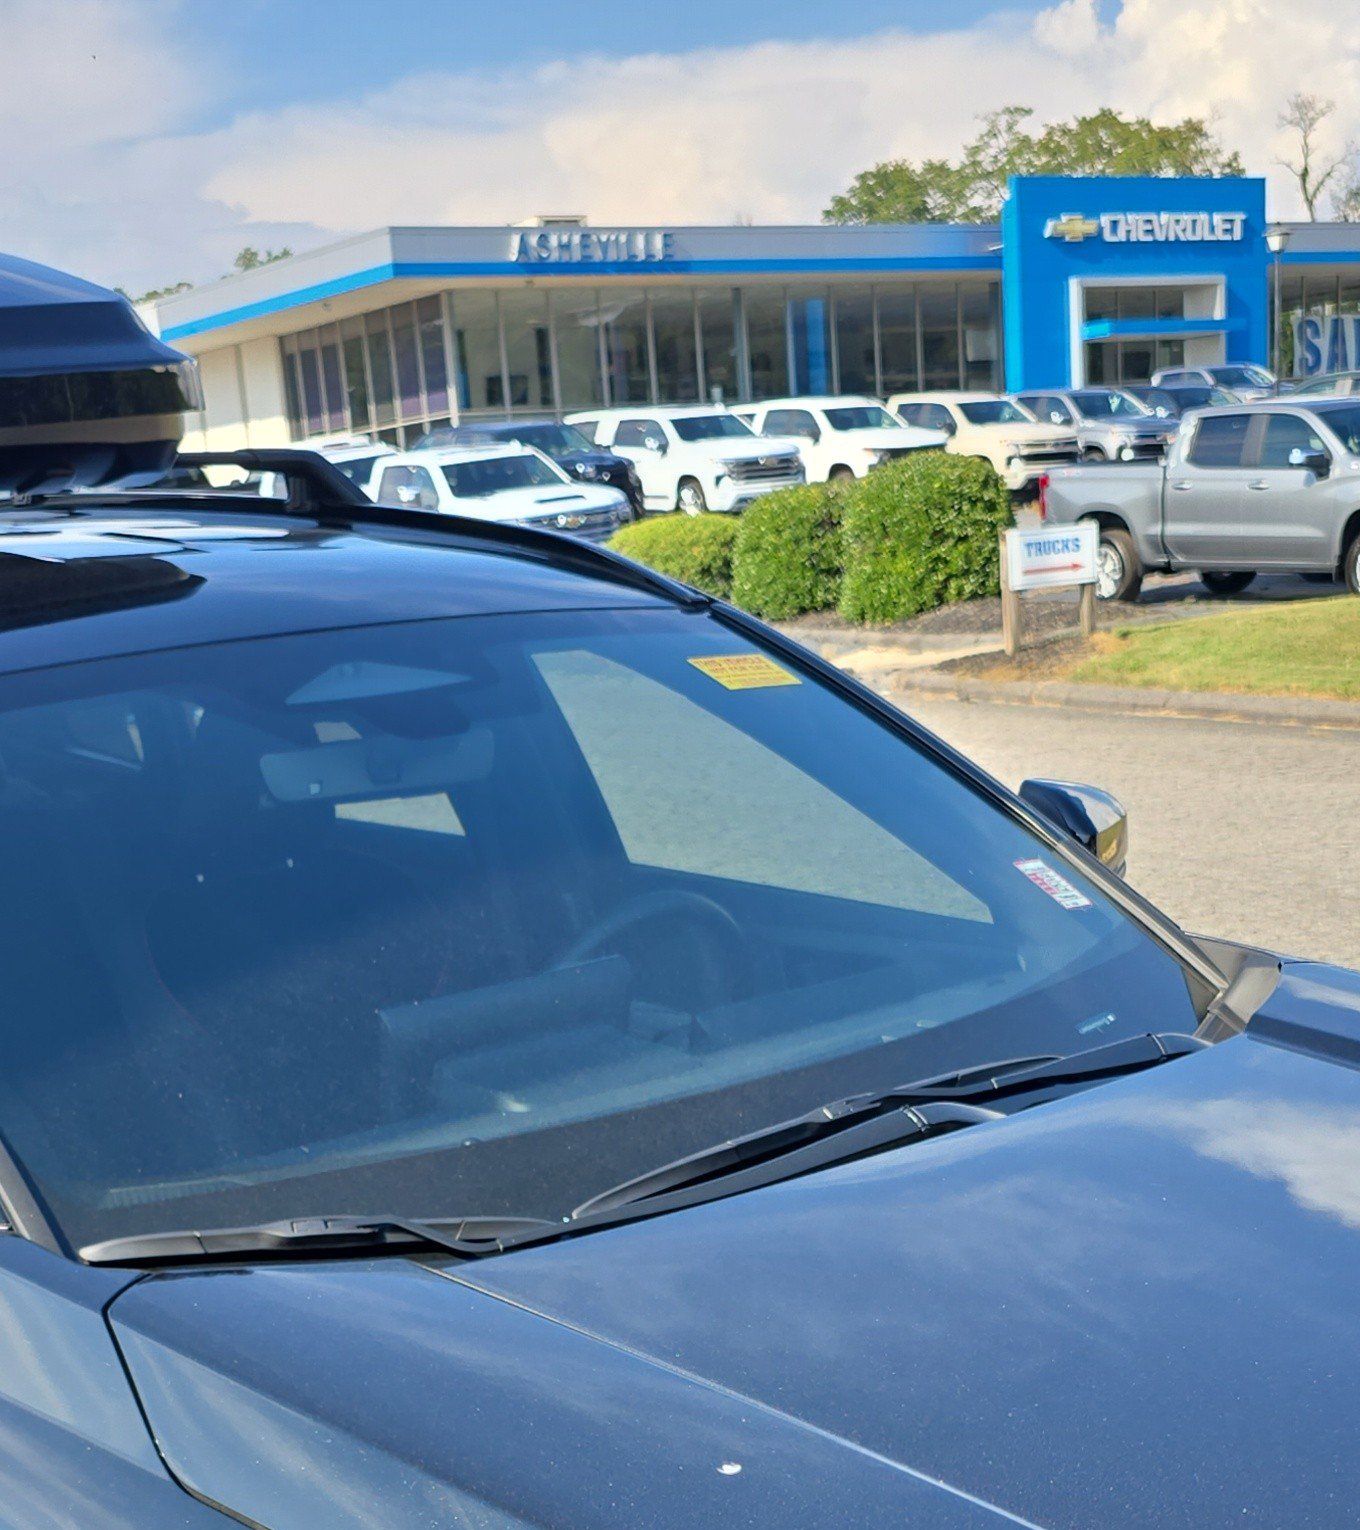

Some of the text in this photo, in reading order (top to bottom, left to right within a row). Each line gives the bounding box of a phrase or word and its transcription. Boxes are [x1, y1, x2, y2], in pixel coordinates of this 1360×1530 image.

[1100, 211, 1248, 243] CHEVROLET
[510, 232, 674, 263] ASHEVILLE
[1024, 537, 1081, 558] TRUCKS
